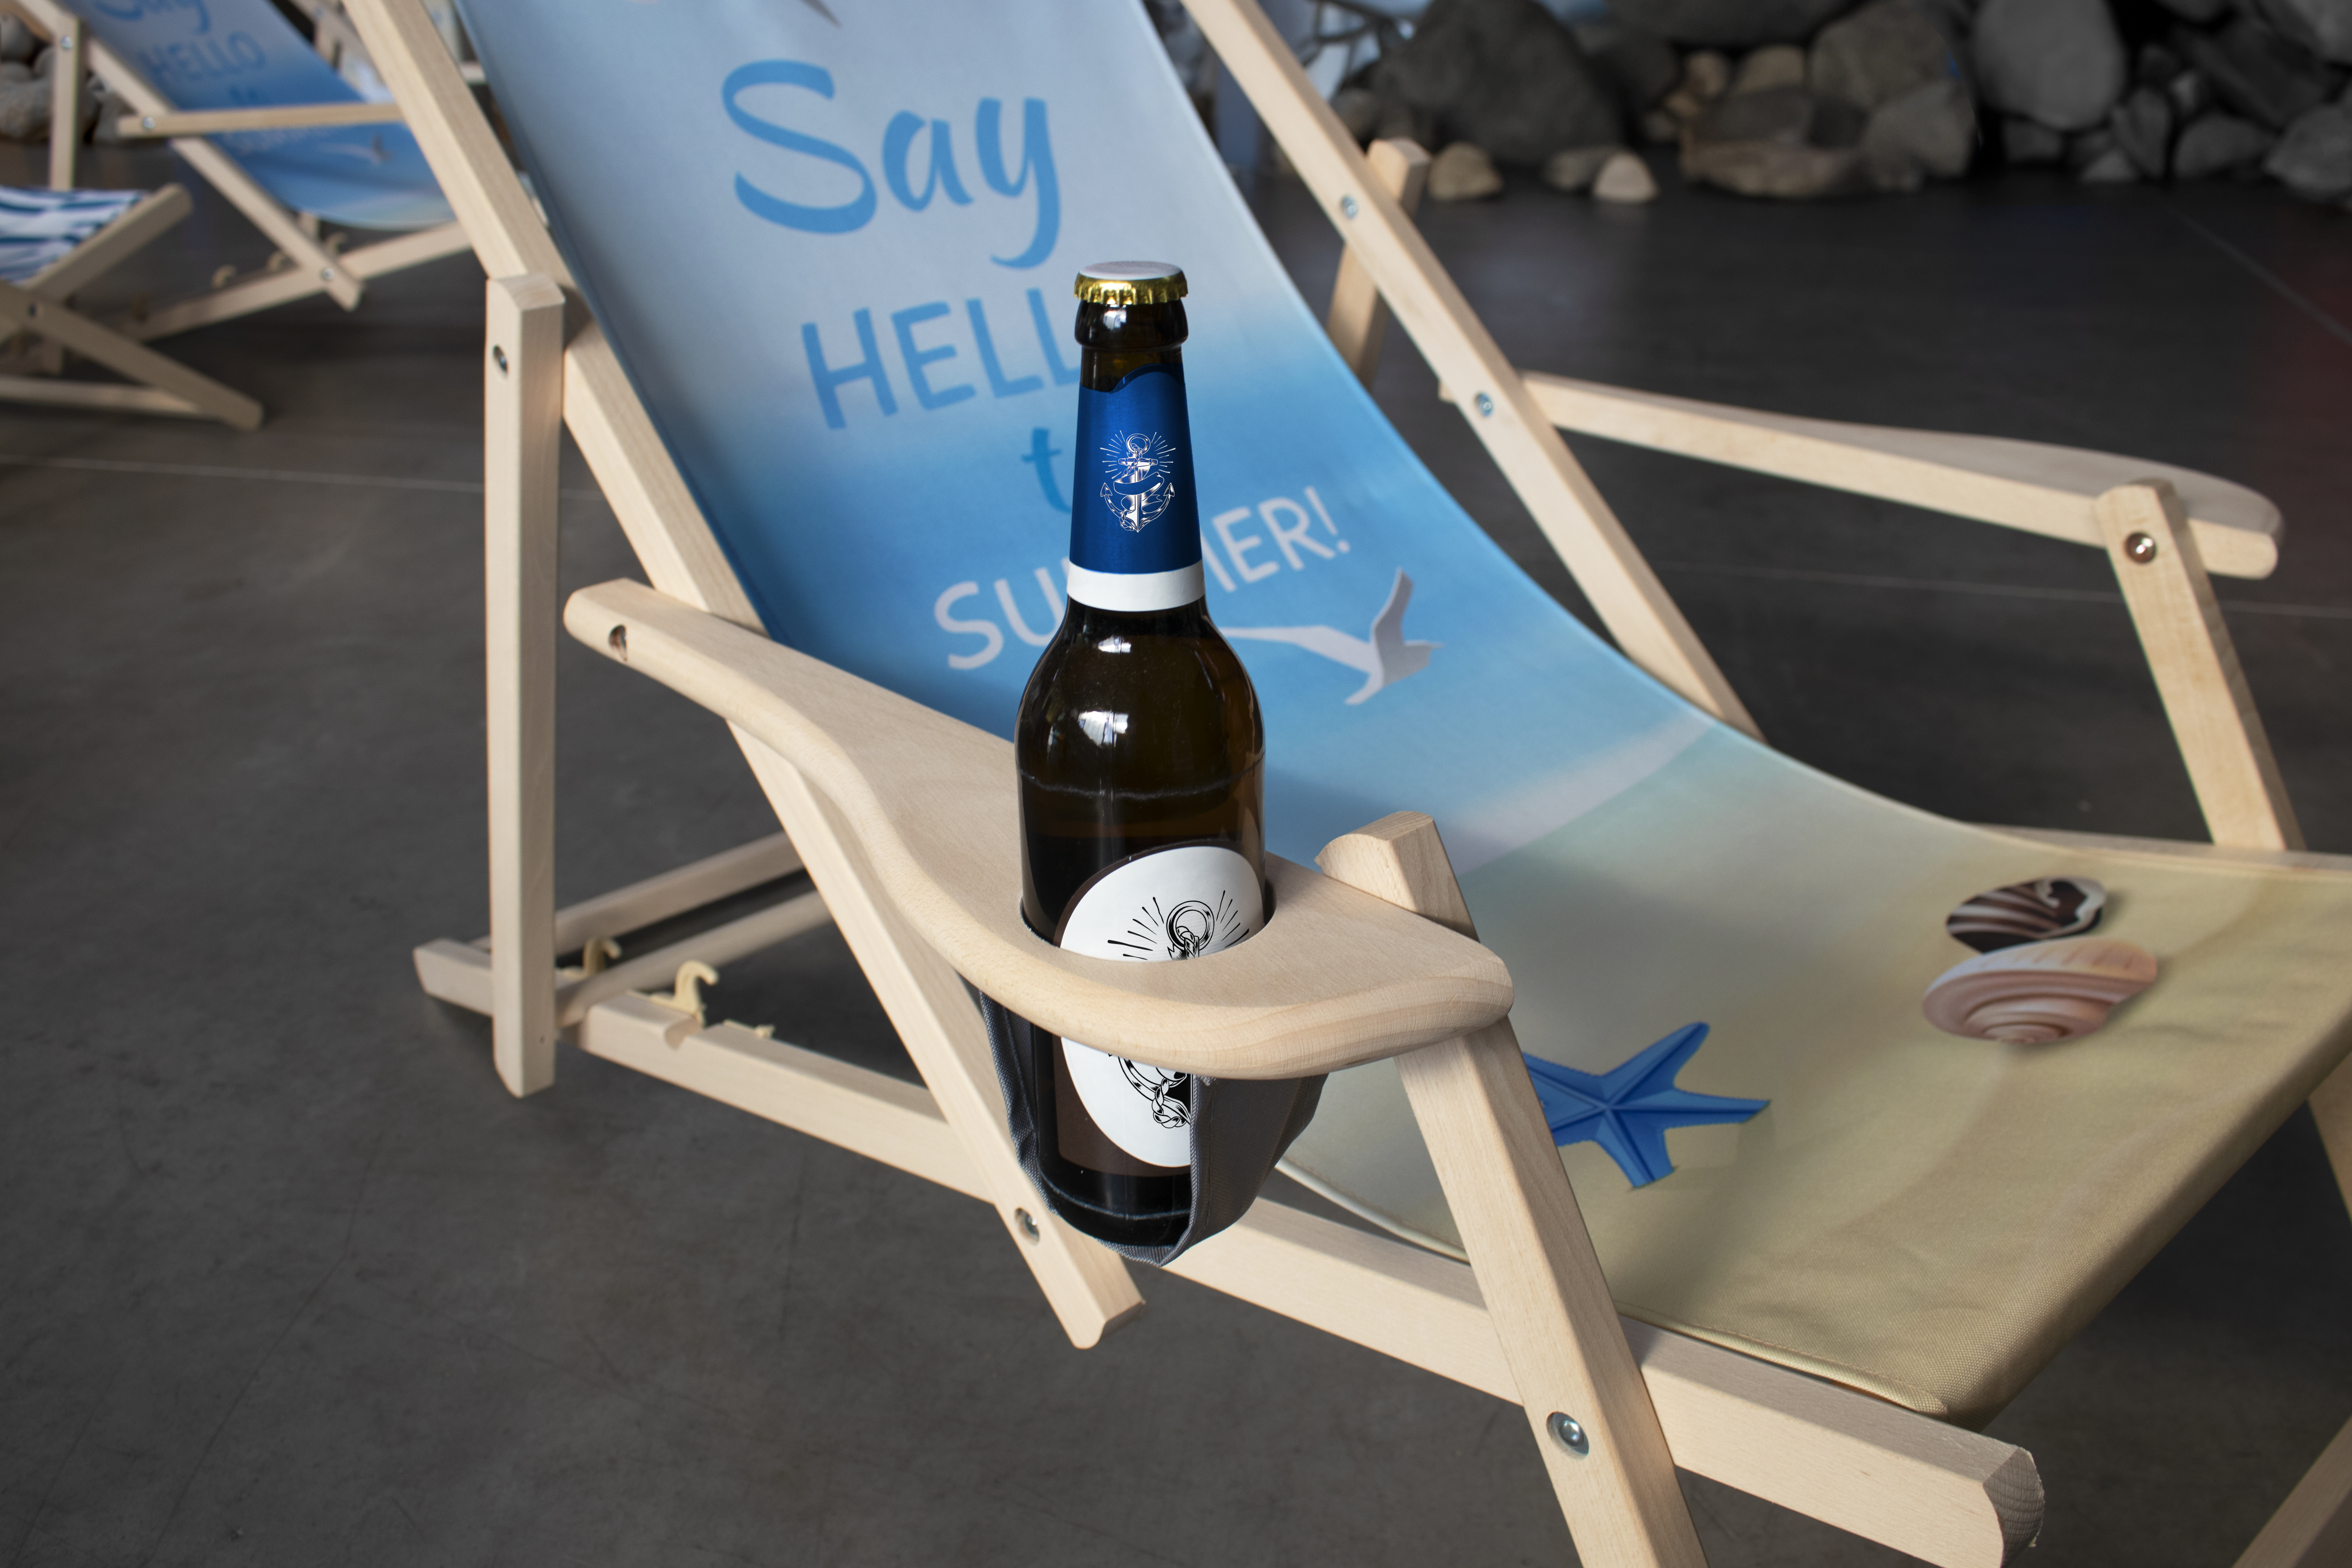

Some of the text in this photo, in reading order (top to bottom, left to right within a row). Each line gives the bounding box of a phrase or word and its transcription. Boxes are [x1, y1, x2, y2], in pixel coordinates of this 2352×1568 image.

[721, 59, 1061, 269] Say
[801, 287, 1081, 430] HELL
[1021, 427, 1073, 513] t
[933, 486, 1350, 670] SUER!
